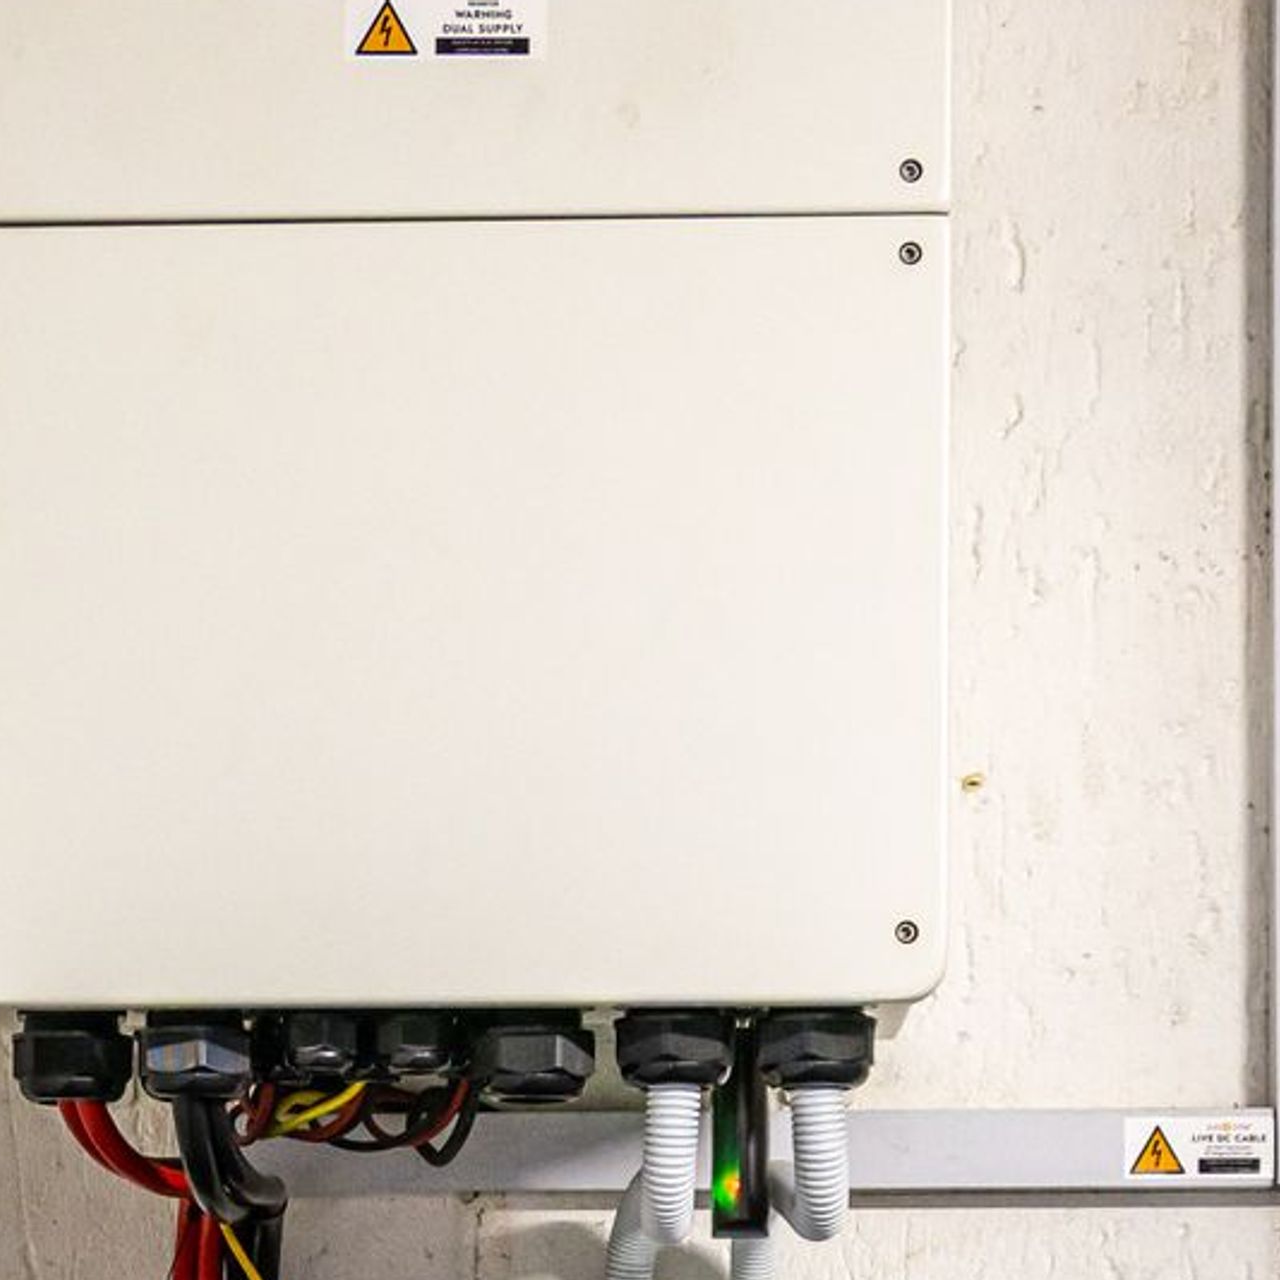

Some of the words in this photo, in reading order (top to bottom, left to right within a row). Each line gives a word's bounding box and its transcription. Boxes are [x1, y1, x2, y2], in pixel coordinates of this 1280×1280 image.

[455, 10, 512, 19] WARNING
[443, 24, 473, 34] DUAL
[479, 24, 523, 34] SUPPLY
[1192, 1134, 1213, 1143] LIVE
[1235, 1134, 1267, 1143] CABLE
